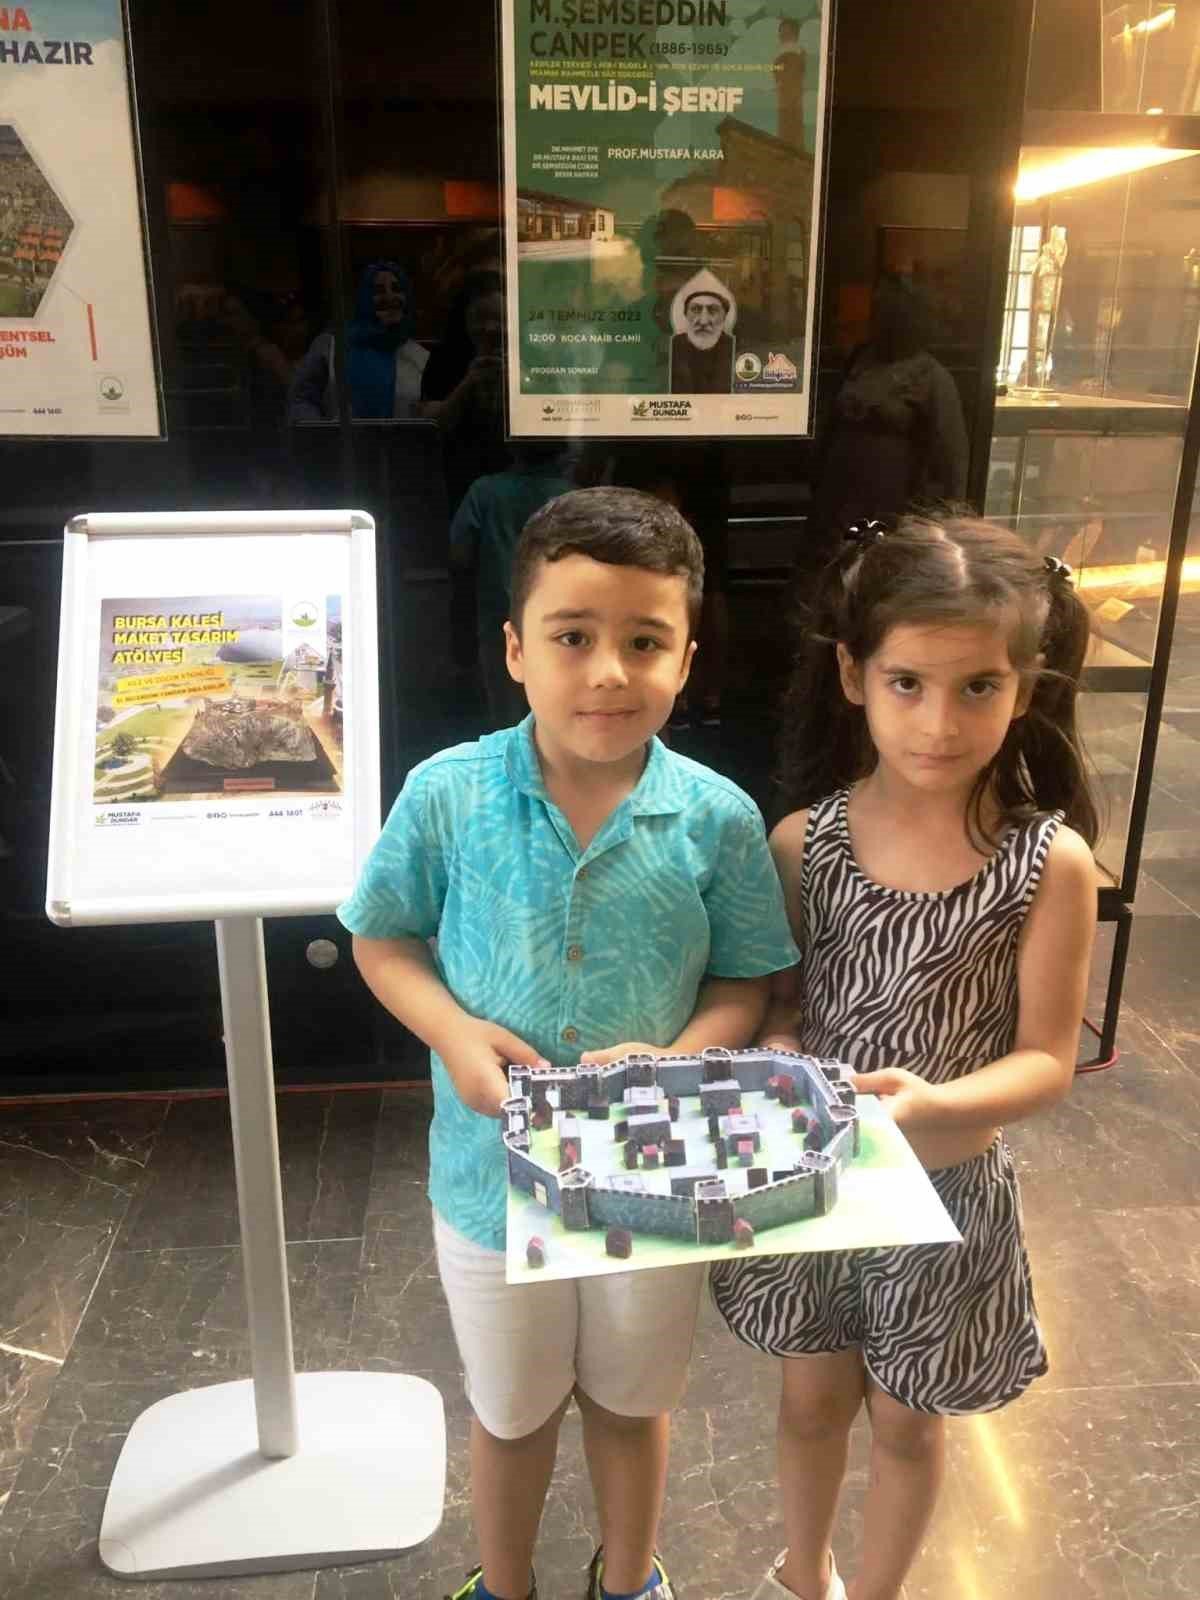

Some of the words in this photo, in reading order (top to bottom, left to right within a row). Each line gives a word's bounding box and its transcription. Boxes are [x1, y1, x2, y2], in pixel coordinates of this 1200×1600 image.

[0, 40, 94, 65] HAZIR
[530, 32, 647, 58] CANPEK
[649, 42, 729, 56] (1886-1965)
[530, 80, 657, 111] MEVLİD-İ
[663, 86, 744, 116] ŞERİF
[607, 148, 691, 160] PROF.MUSTAFA
[694, 149, 725, 160] KARA
[529, 310, 545, 321] 24
[528, 333, 557, 343] 12:00
[650, 400, 692, 409] MUSTAFA
[113, 614, 167, 630] BURSA
[169, 610, 224, 629] KALESİ
[113, 631, 168, 646] MAKET
[171, 629, 240, 645] TASARIM
[112, 647, 185, 664] ATÖLYESİ
